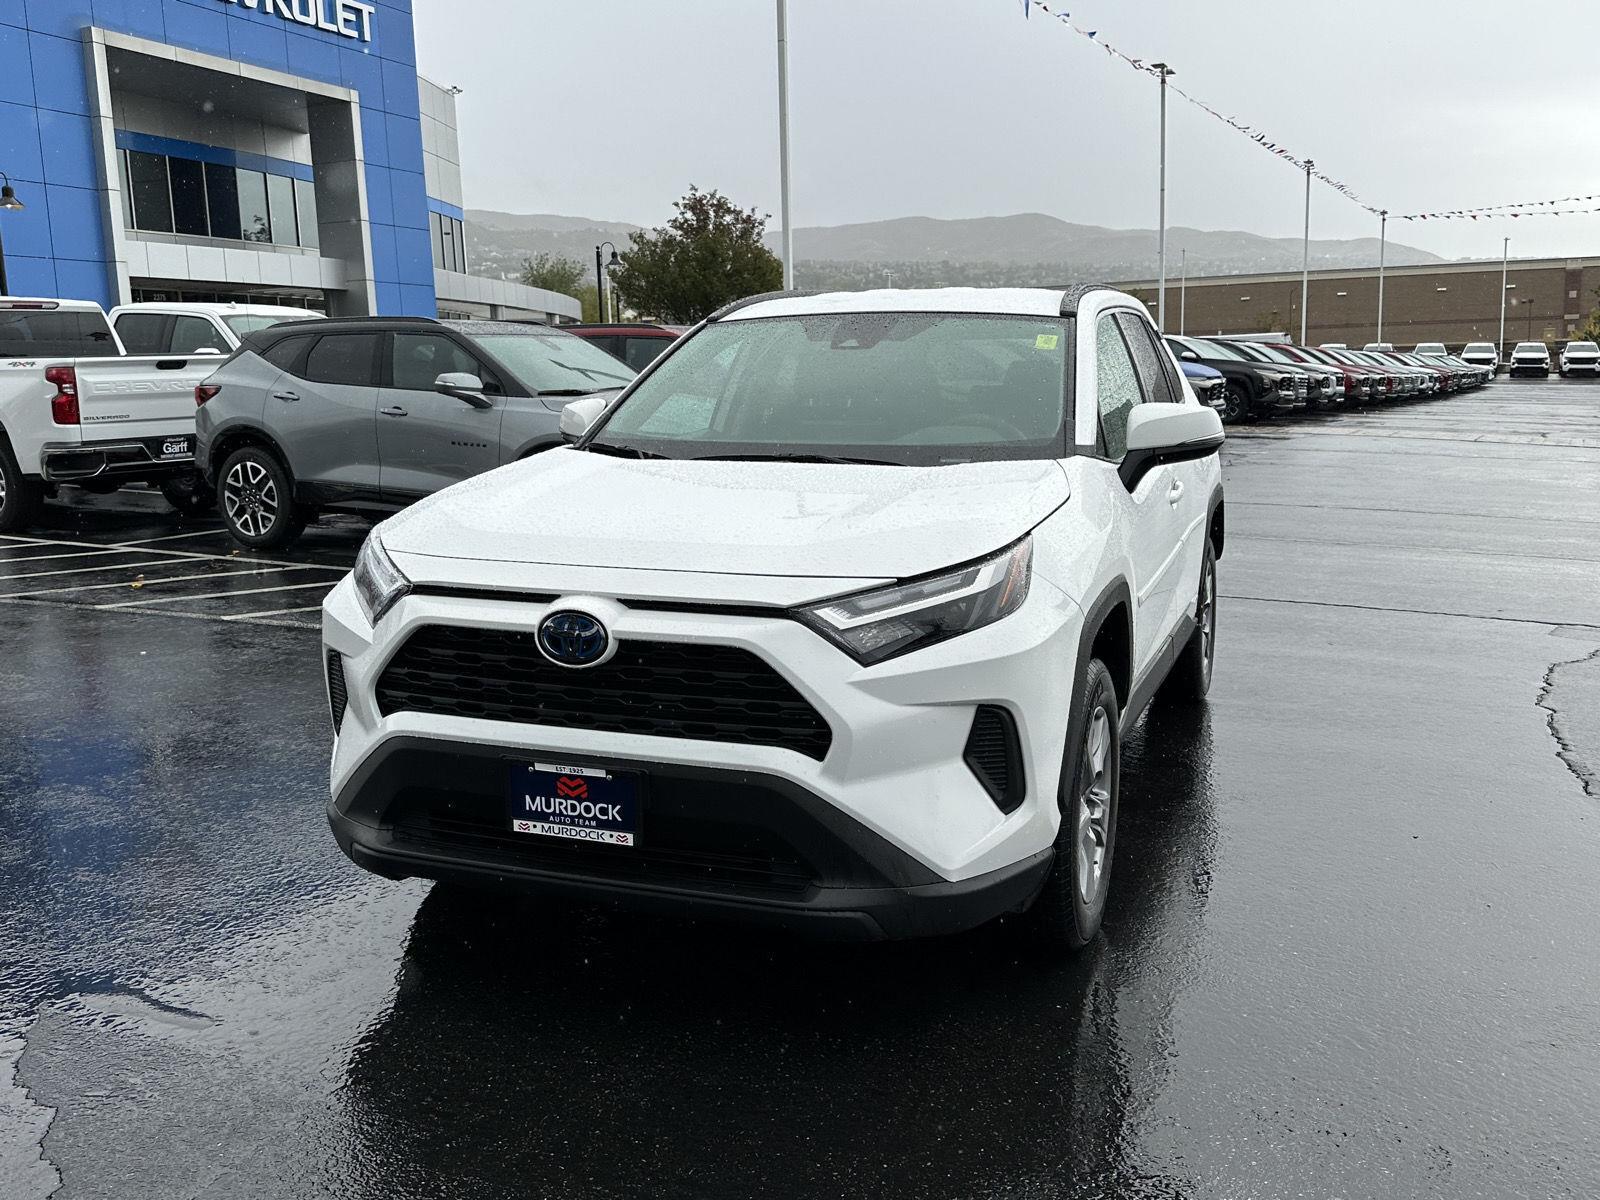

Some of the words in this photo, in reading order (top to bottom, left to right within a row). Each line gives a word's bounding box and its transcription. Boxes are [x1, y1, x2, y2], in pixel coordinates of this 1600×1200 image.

[163, 441, 188, 453] Garff
[569, 767, 585, 775] 1925
[525, 794, 622, 821] MURDOCK
[549, 815, 571, 824] AUTO
[575, 818, 597, 827] TEAM
[541, 824, 606, 841] MURDOCK
